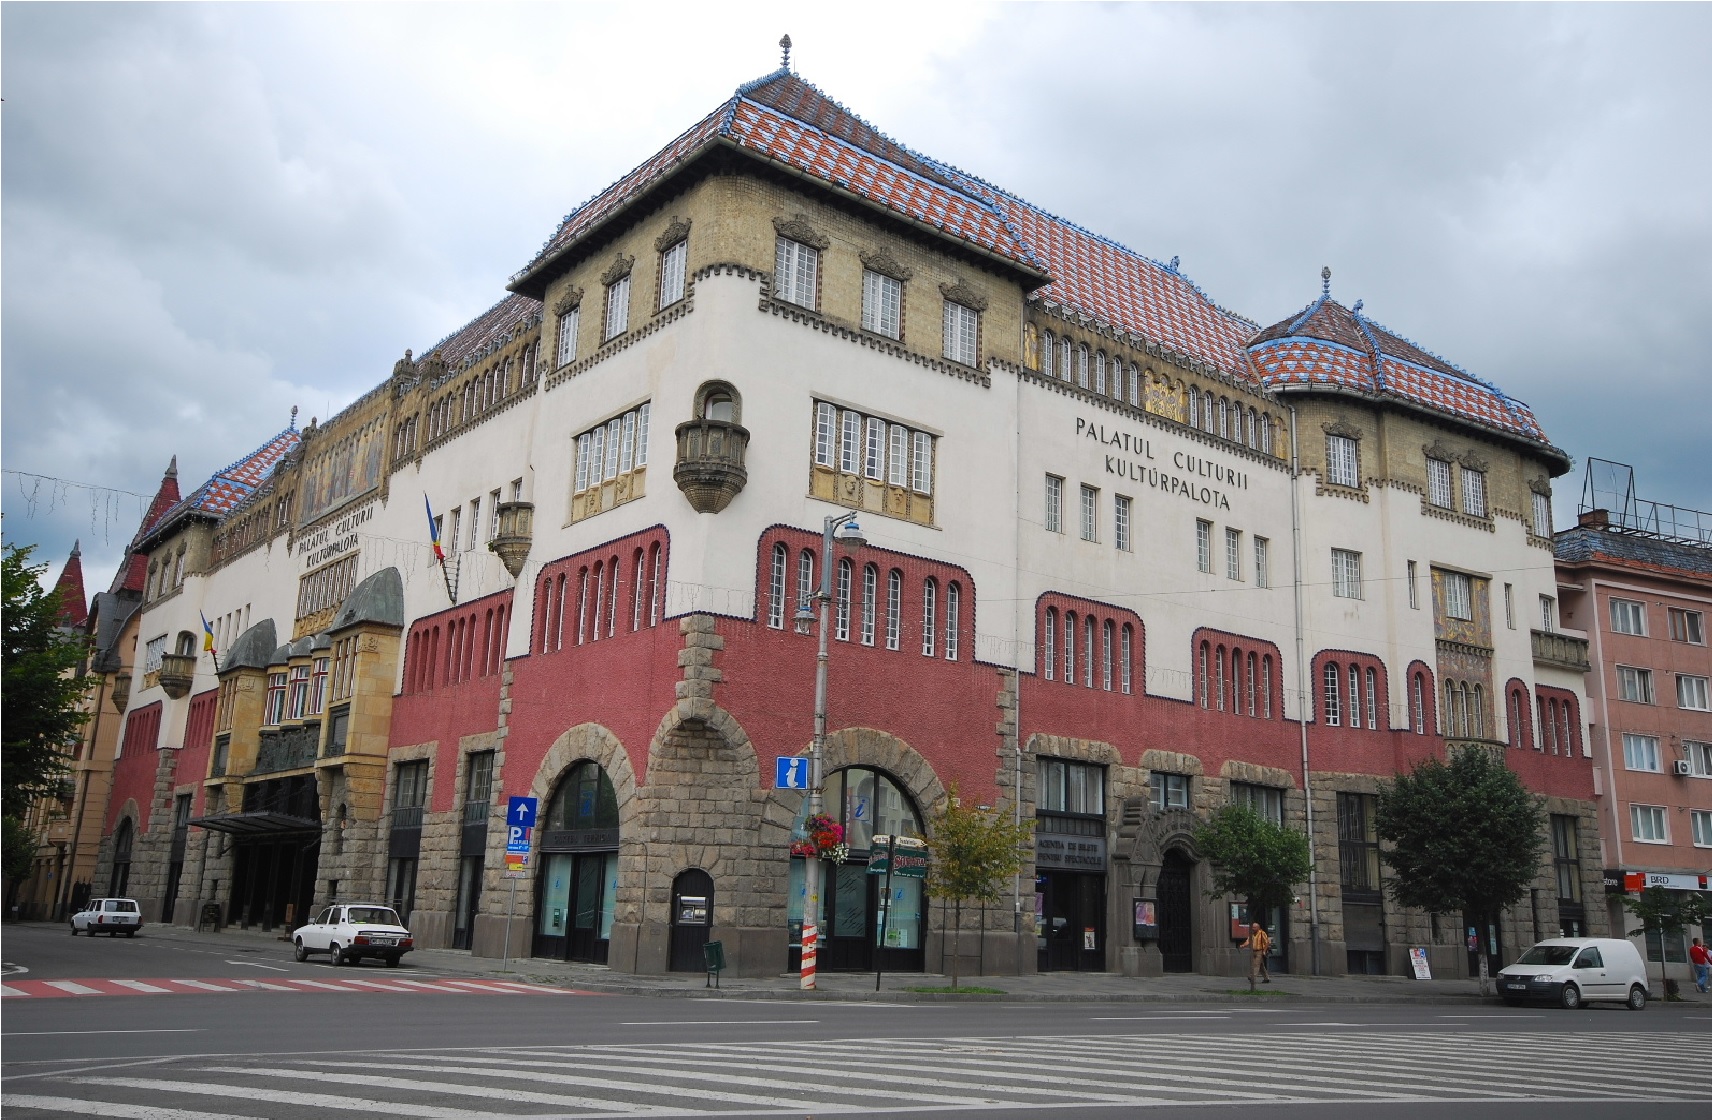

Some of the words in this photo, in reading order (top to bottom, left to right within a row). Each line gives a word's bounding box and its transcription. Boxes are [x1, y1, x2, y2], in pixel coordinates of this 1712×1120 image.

[1076, 417, 1154, 460] PALATUL
[1173, 451, 1248, 490] CULTURII
[298, 530, 329, 555] PALATUL
[335, 507, 374, 536] CULTURII
[509, 826, 522, 845] P
[1650, 875, 1669, 885] BRD
